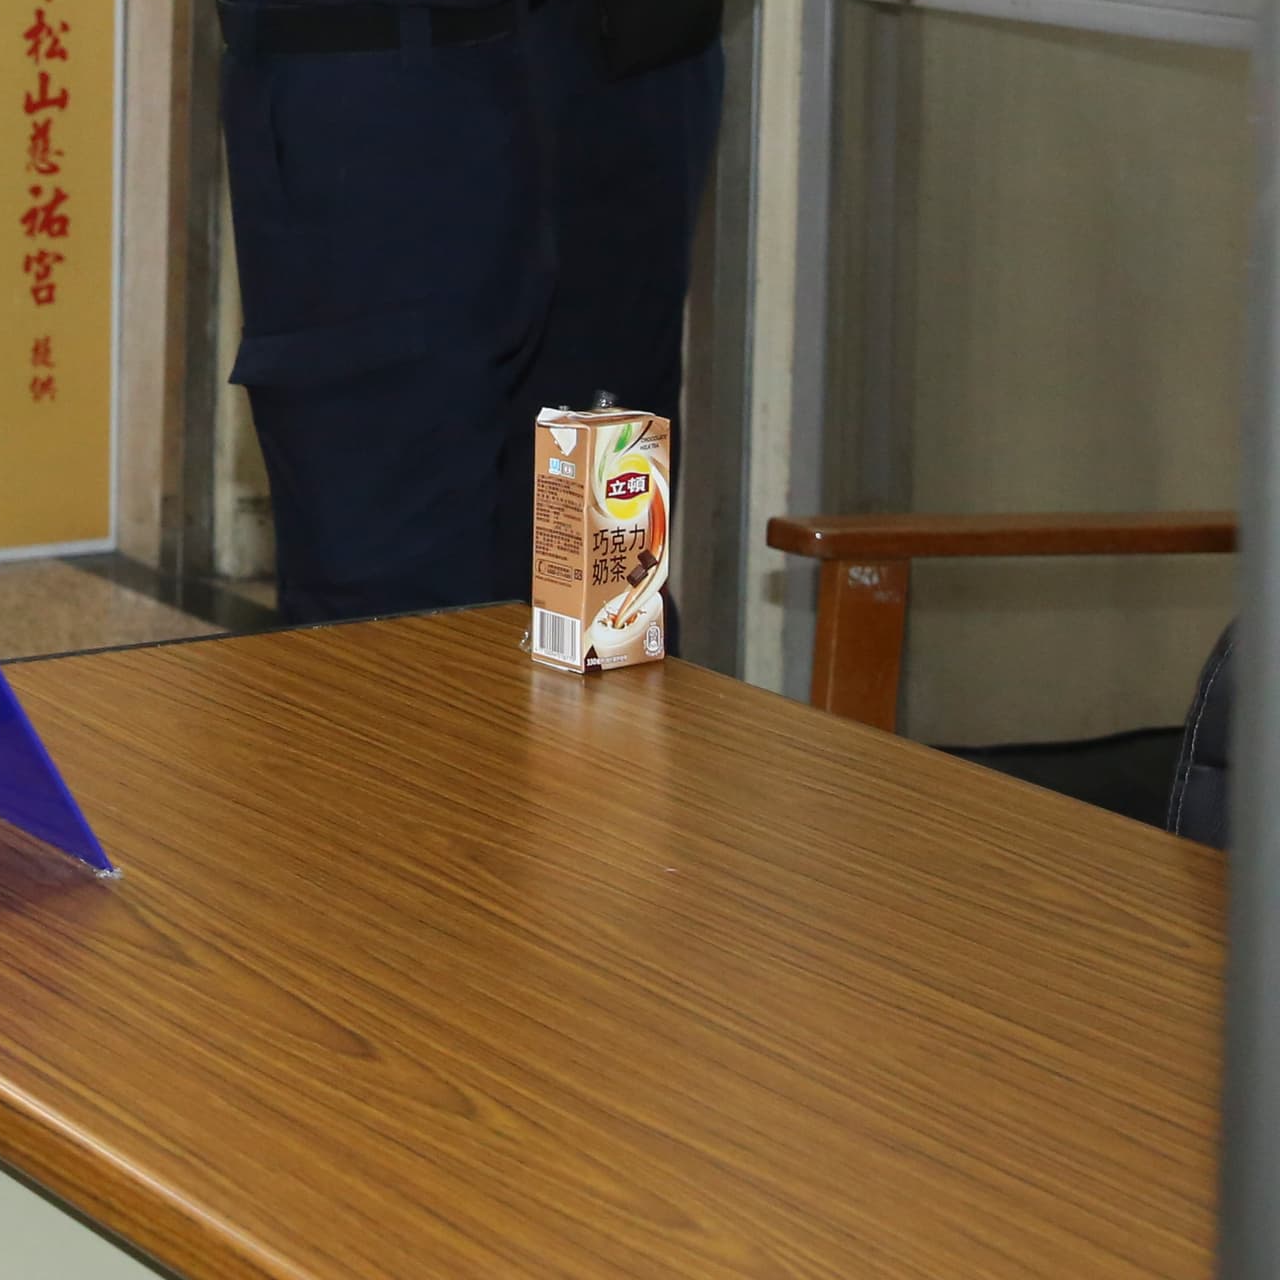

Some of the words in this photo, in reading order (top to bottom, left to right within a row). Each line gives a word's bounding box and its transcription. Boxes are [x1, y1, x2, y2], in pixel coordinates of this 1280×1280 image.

[608, 475, 647, 497] 立頓
[592, 525, 647, 555] 巧克力
[592, 557, 627, 587] 奶茶
